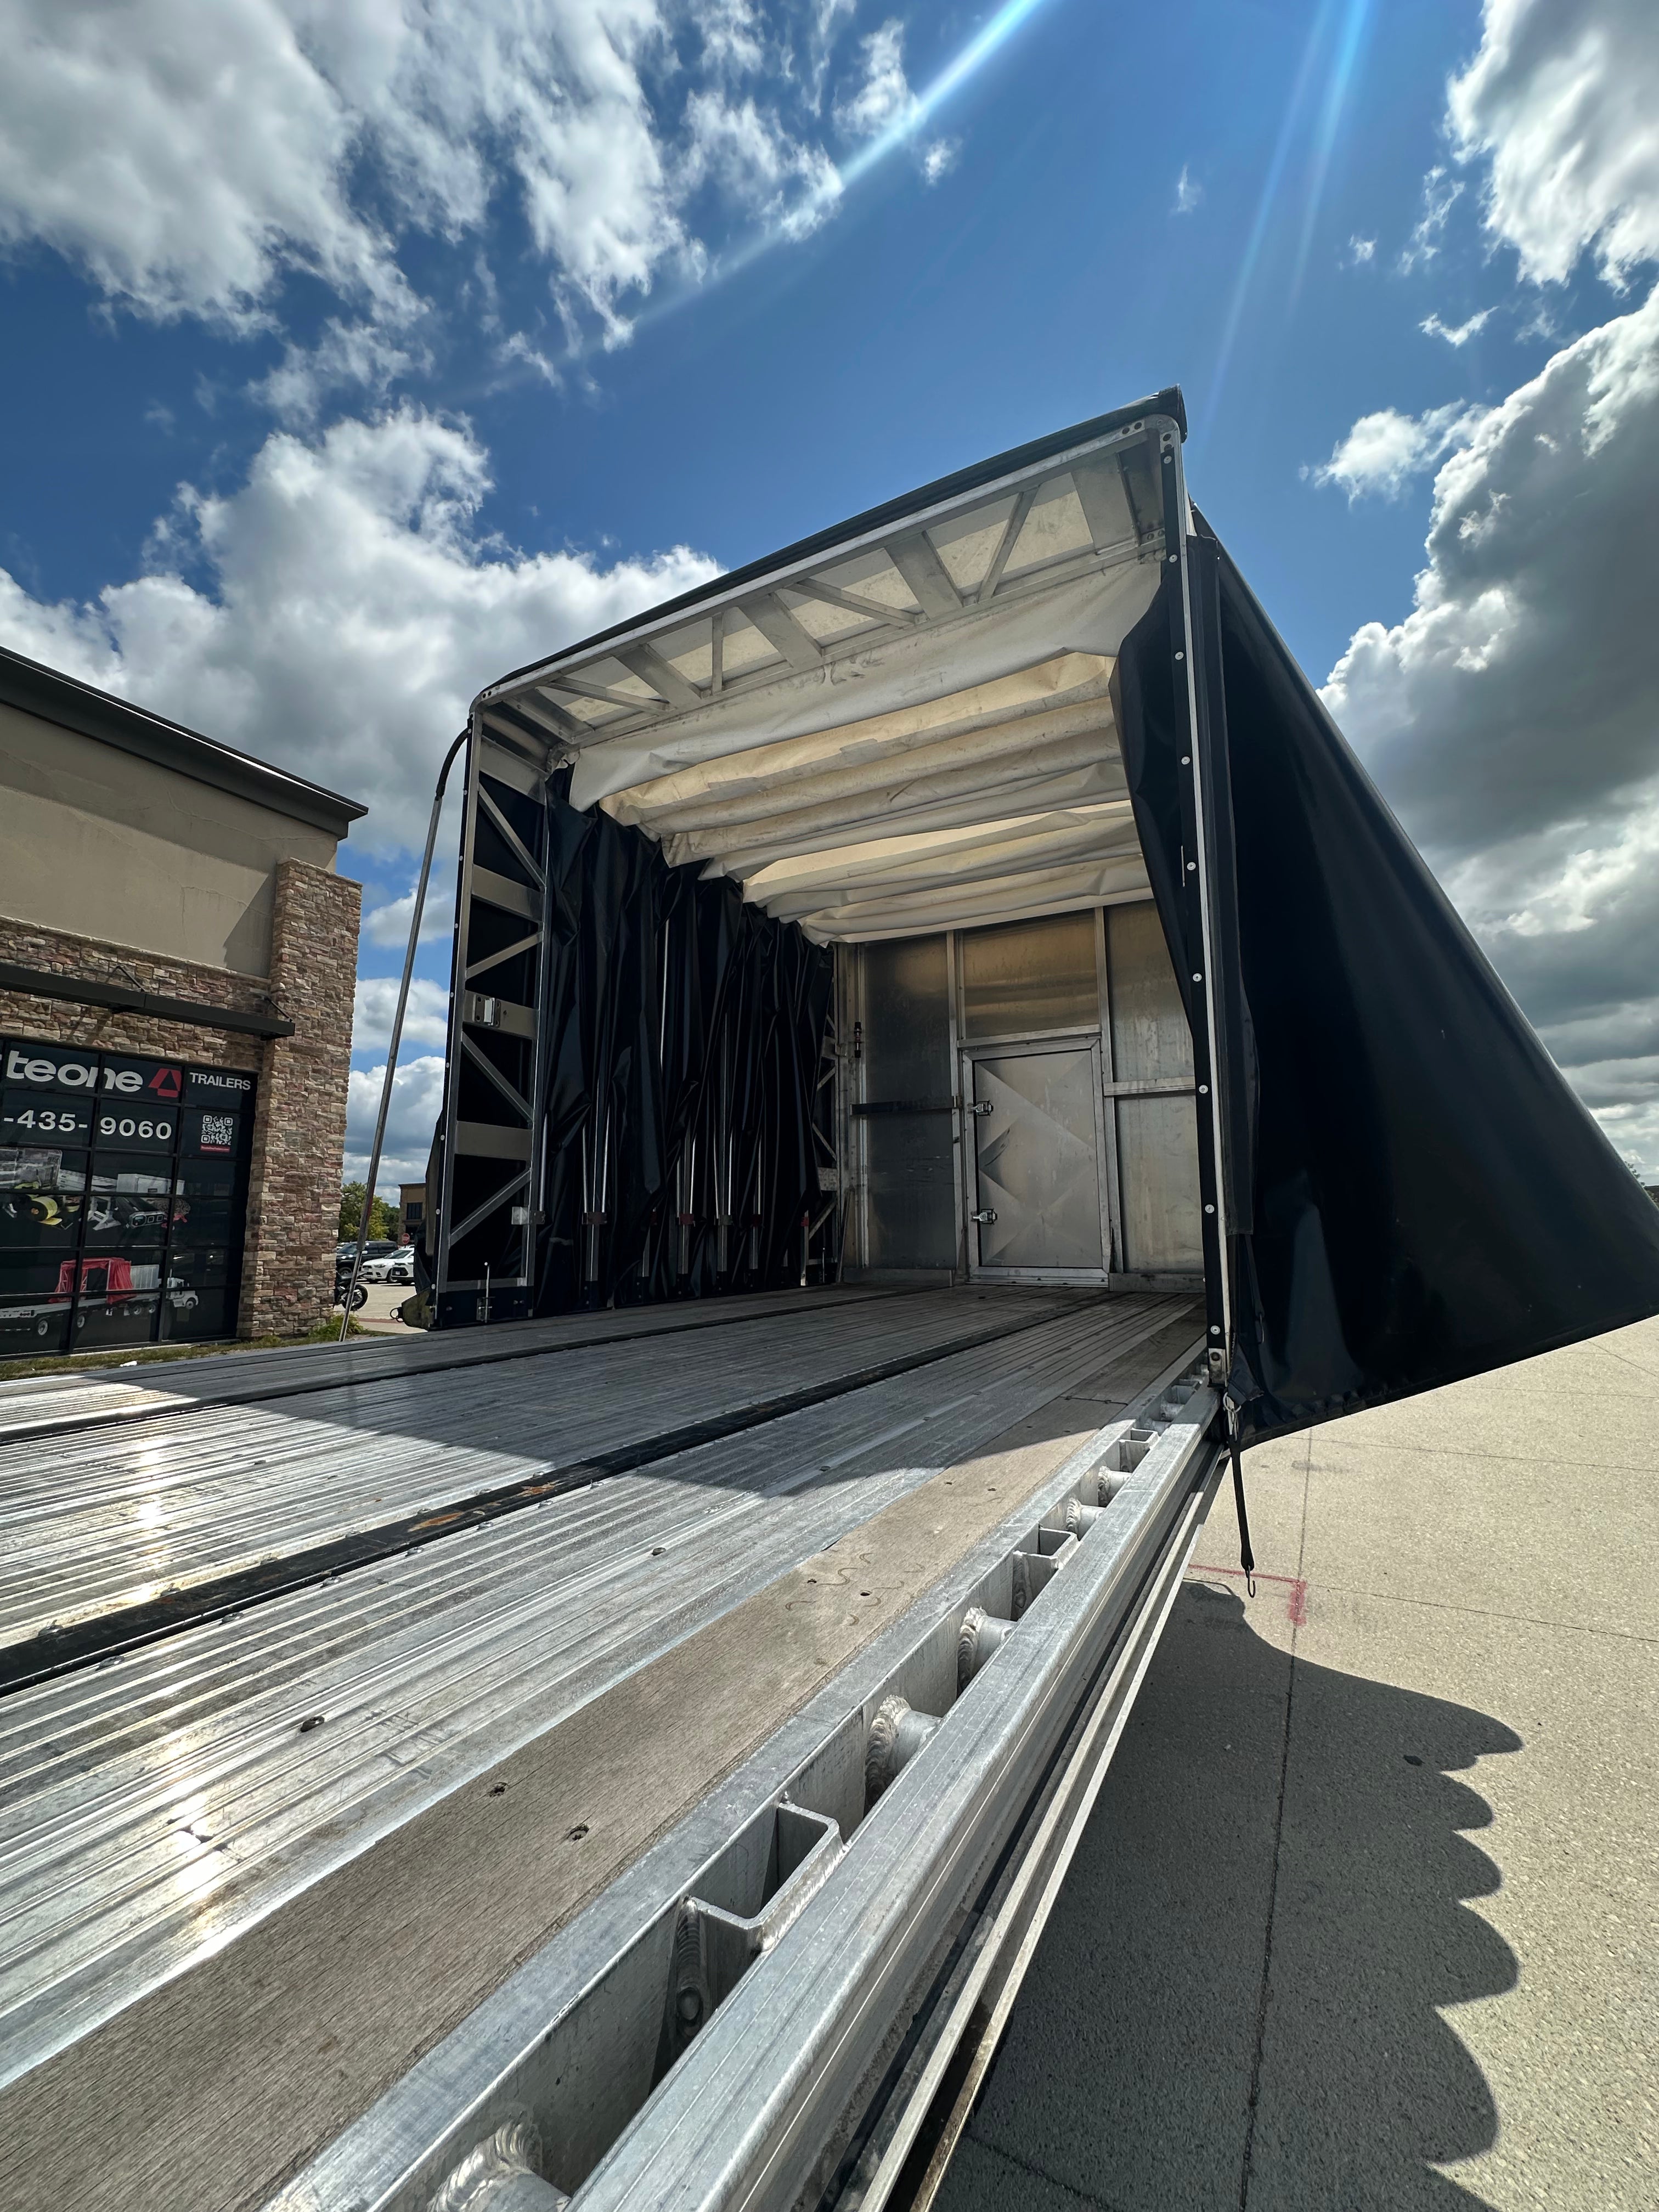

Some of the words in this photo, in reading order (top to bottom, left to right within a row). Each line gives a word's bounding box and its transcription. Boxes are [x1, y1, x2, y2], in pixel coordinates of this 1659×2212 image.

[0, 1050, 143, 1092] teone
[189, 1071, 251, 1090] TRAILERS
[3, 1110, 88, 1131] -435-
[100, 1117, 172, 1139] 9060
